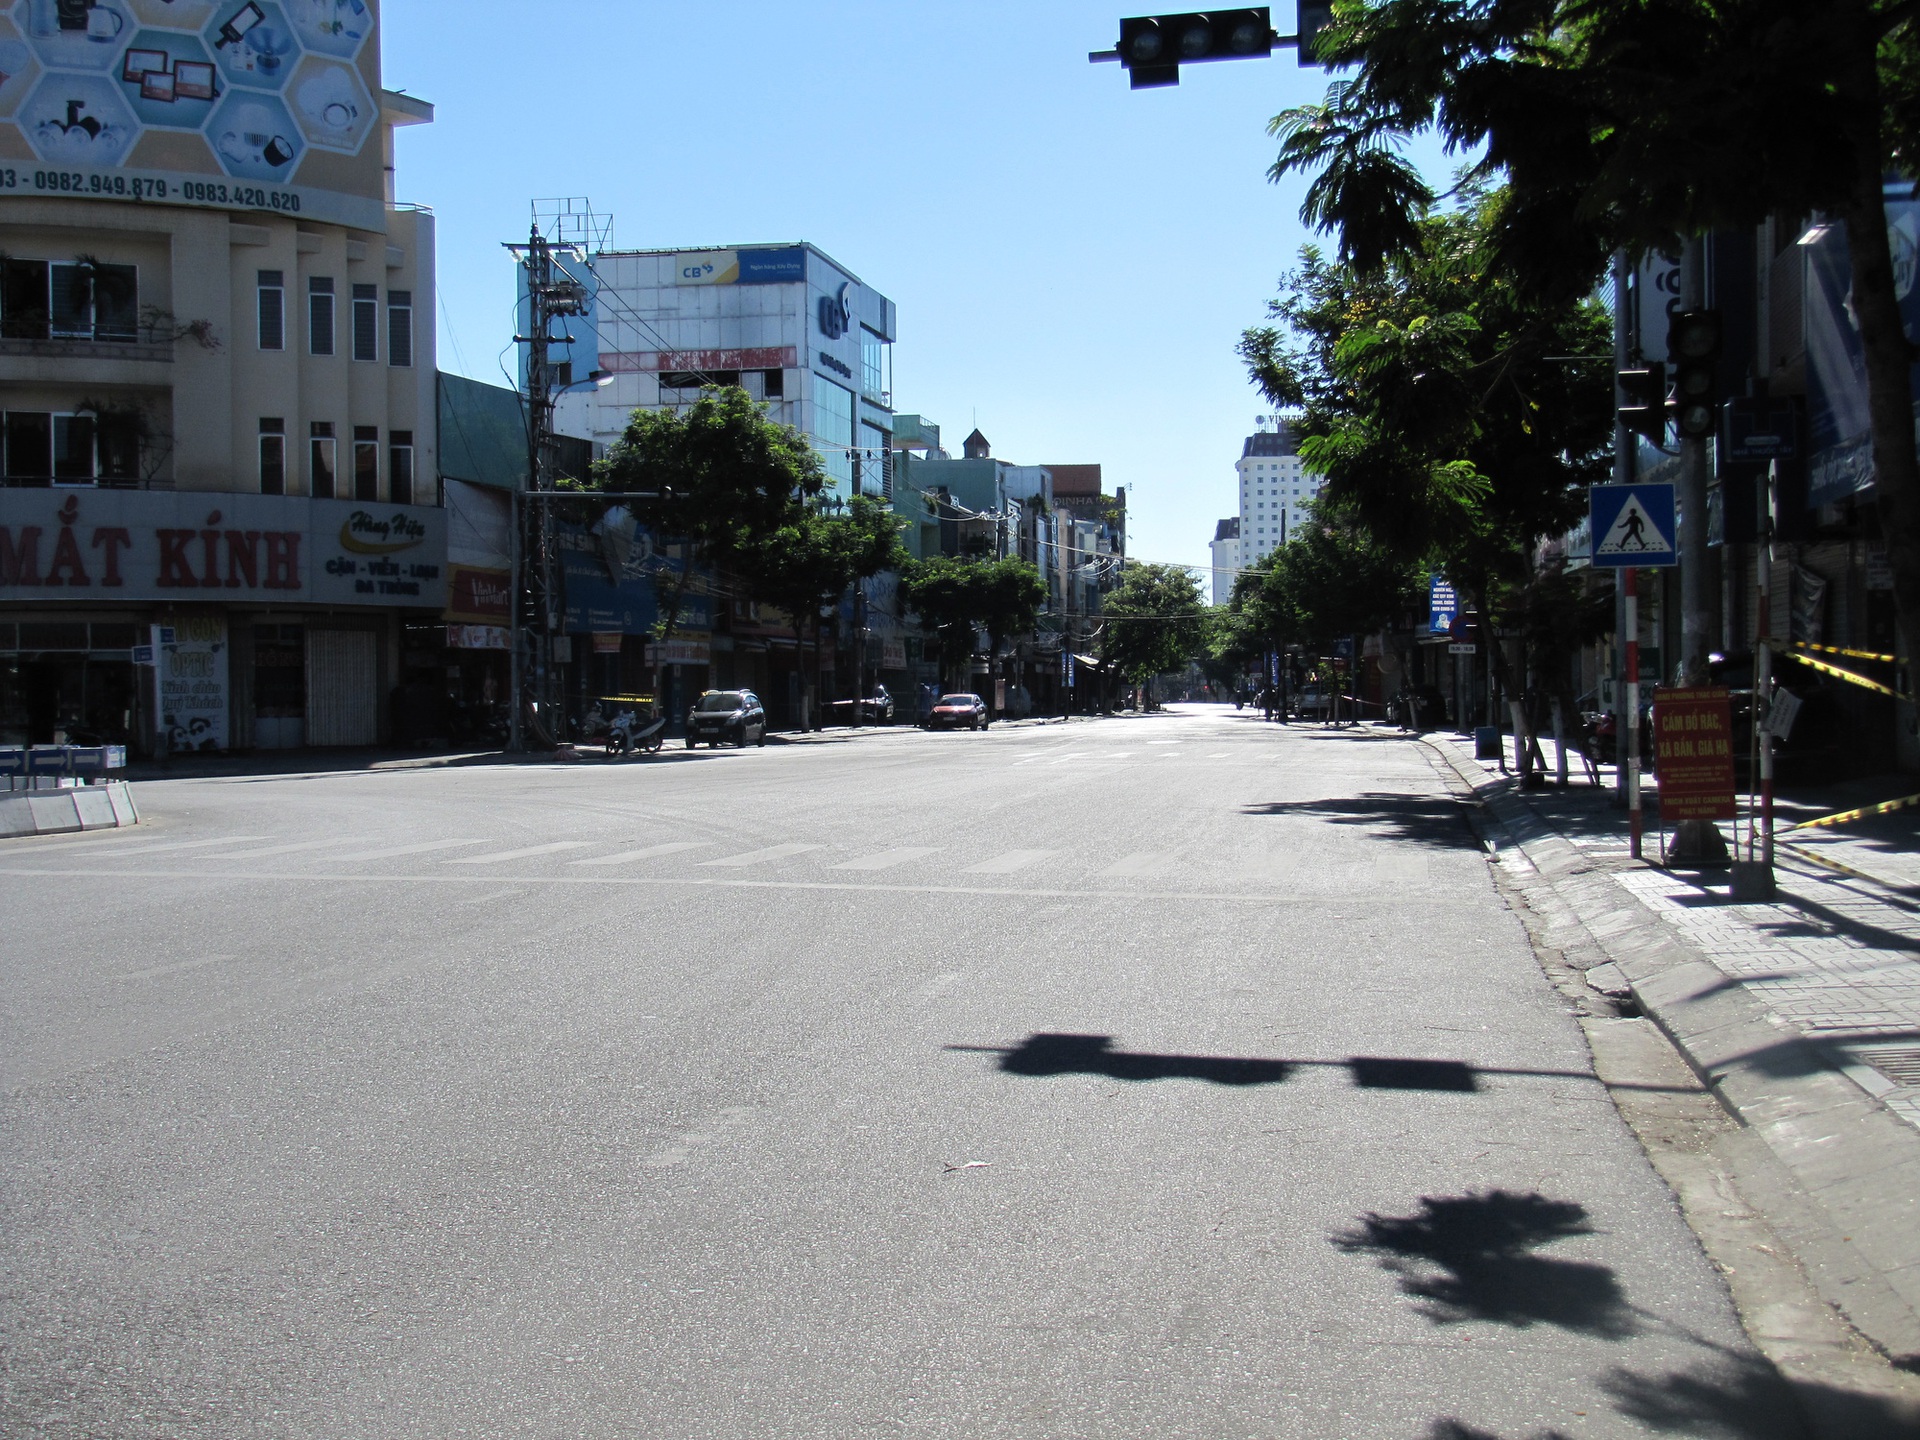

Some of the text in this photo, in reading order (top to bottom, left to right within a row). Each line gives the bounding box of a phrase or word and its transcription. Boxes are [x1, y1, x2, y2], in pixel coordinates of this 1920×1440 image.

[35, 170, 167, 198] 0982.949.879
[184, 181, 301, 211] 0983.420.620
[683, 267, 701, 278] CB
[0, 494, 301, 590] MẮT KÍNH
[170, 651, 215, 678] OPTIC
[1662, 708, 1722, 732] CẤM ĐỔ RÁC,
